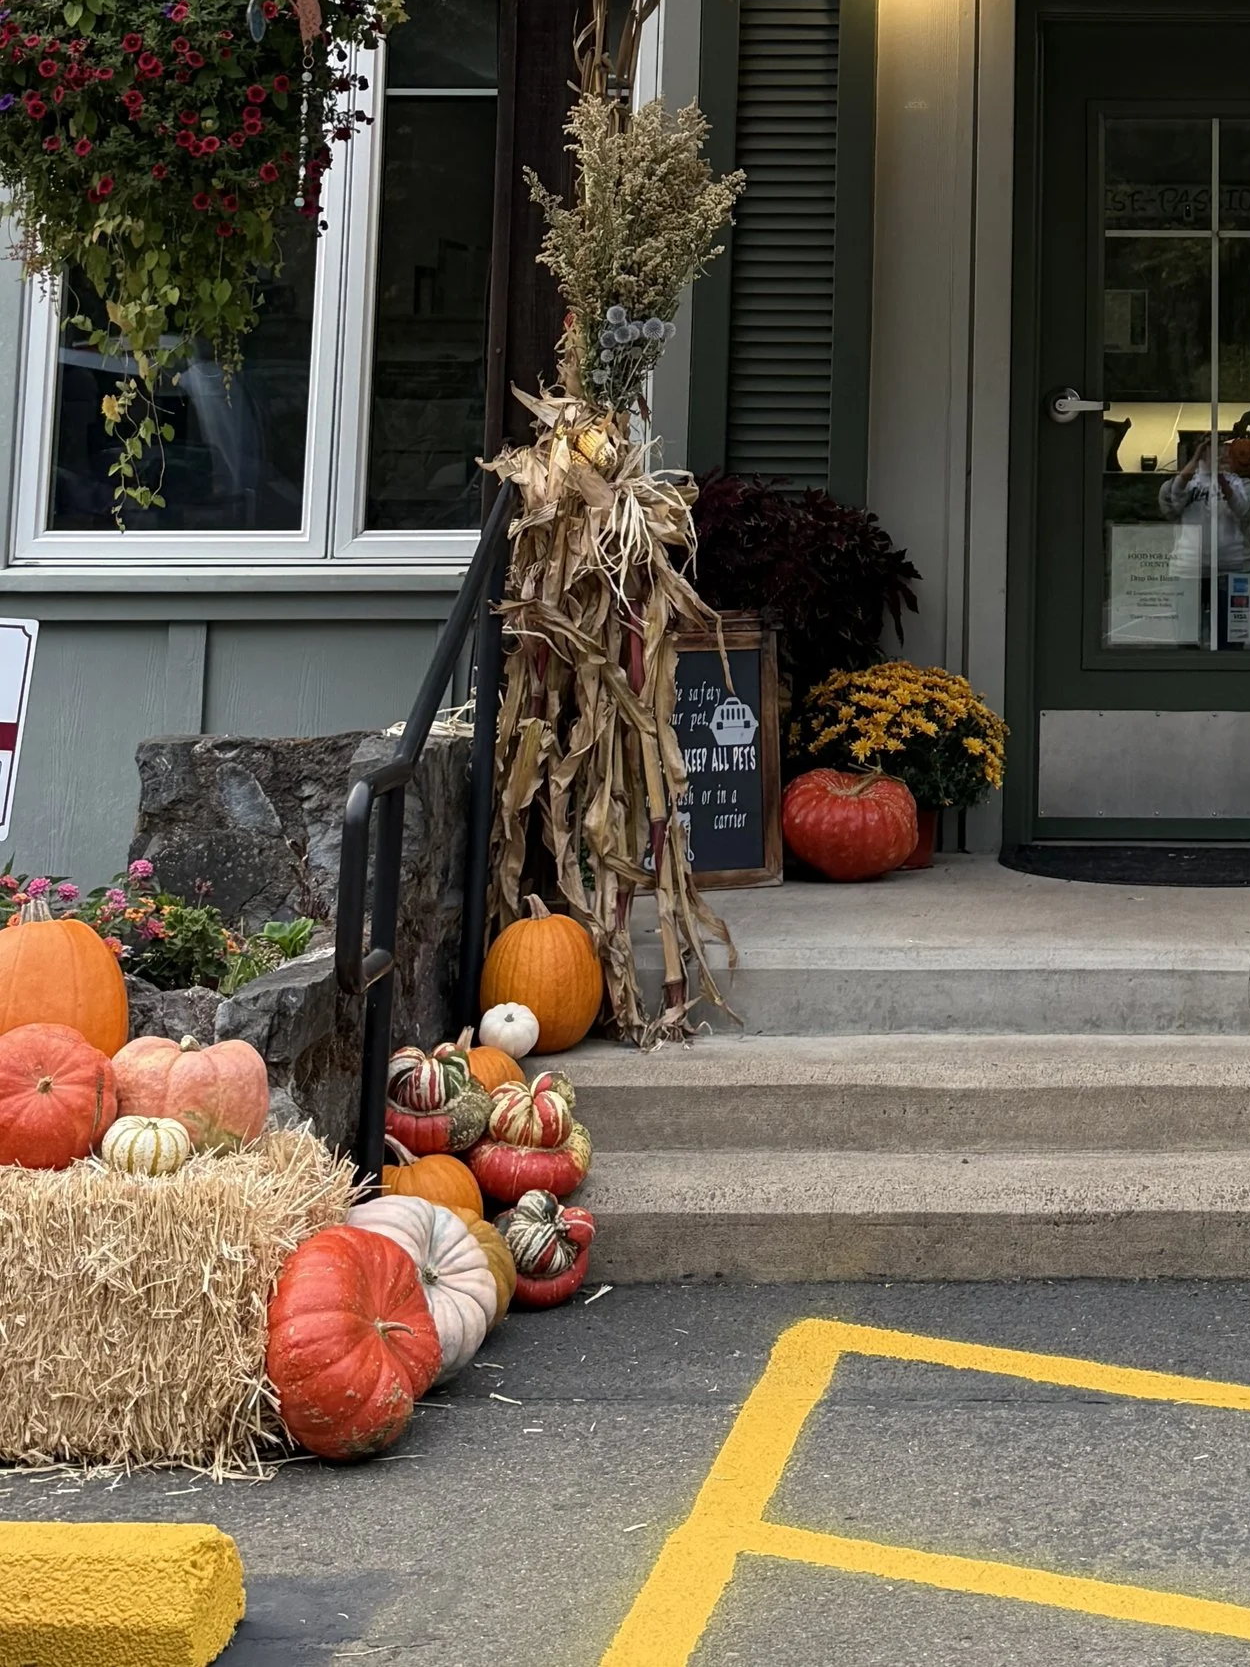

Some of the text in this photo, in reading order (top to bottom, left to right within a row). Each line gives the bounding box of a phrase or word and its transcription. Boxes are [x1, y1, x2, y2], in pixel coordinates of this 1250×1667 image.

[688, 681, 720, 708] safety
[684, 748, 708, 774] KEEP
[711, 747, 731, 773] ALL
[732, 746, 757, 772] PETS
[702, 789, 712, 806] or
[717, 784, 728, 804] in
[731, 790, 738, 804] a
[714, 809, 748, 830] carrier
